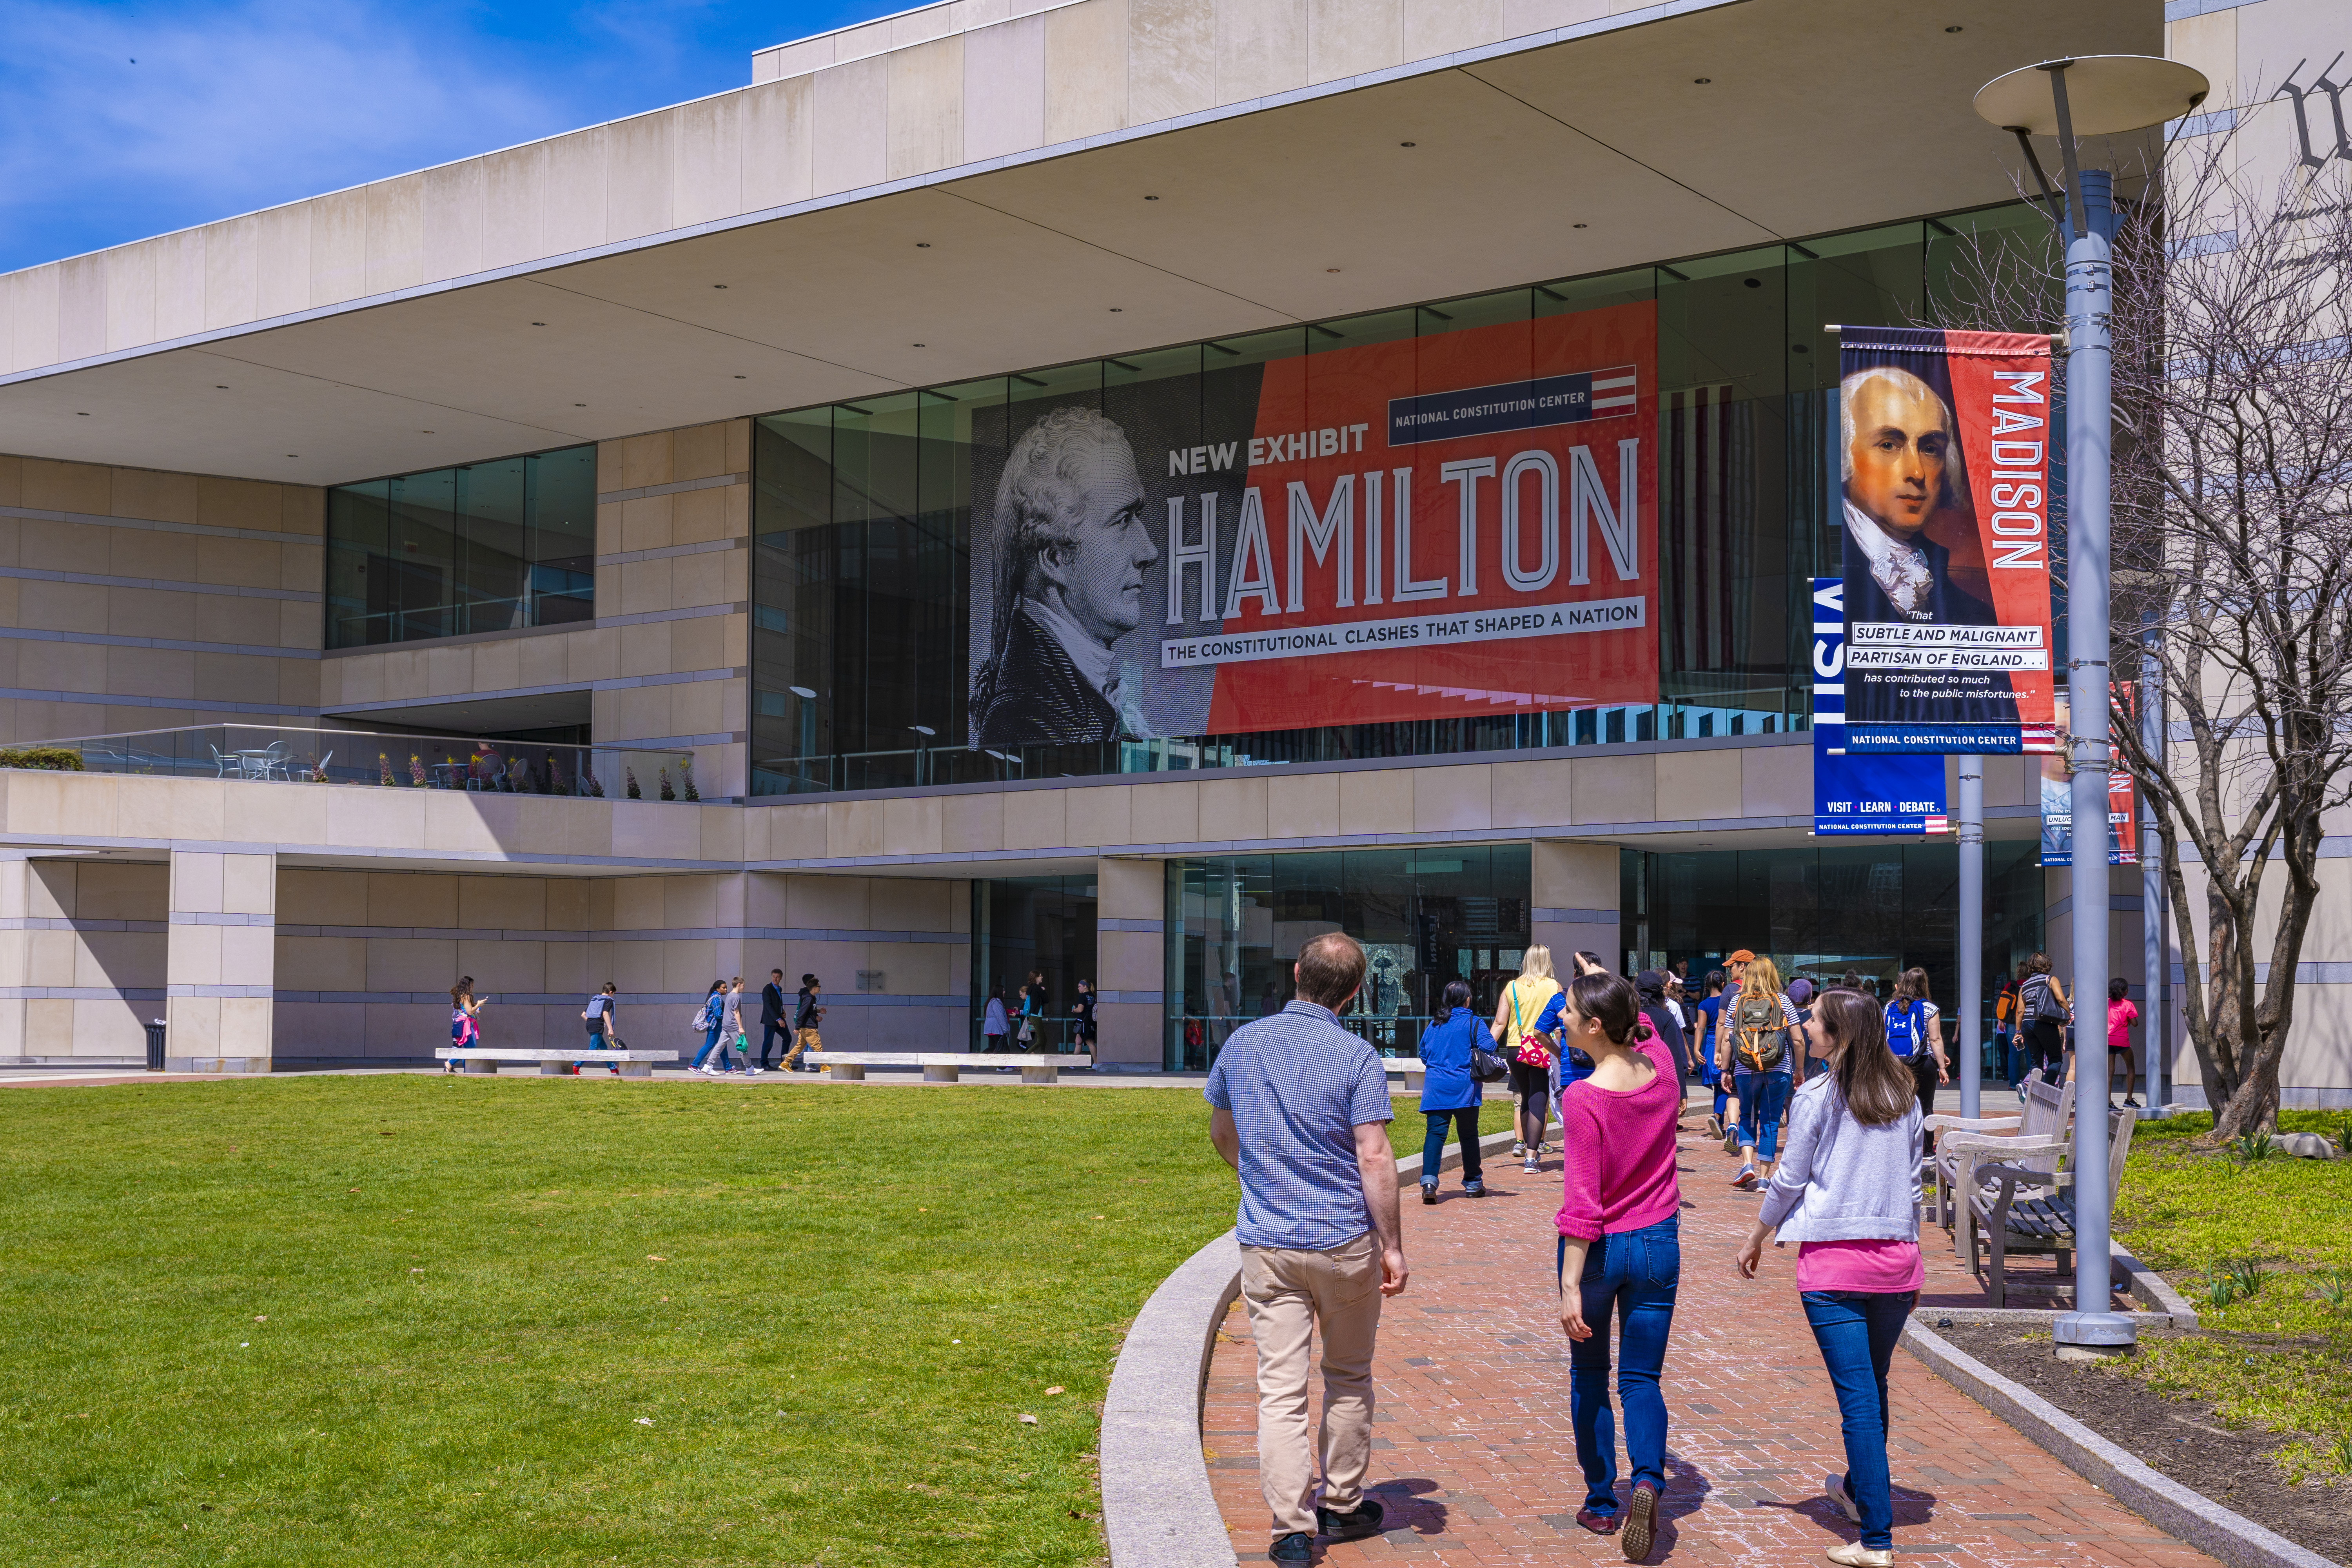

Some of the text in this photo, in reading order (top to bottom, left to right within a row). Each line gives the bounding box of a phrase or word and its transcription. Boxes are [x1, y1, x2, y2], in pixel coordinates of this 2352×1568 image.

[1396, 392, 1585, 428] NATIONAL CONSTITUTION CENTER
[1169, 423, 1368, 477] NEW EXHIBIT
[1991, 370, 2045, 569] MADISON
[1166, 437, 1640, 625] HAMILTON
[1906, 611, 1933, 620] “That
[1168, 605, 1638, 660] THE CONSTITUTIONAL CLASHES THAT SHAPED A NATION
[1856, 628, 2037, 642] SUBTLE AND MALIGNANT
[1814, 583, 1845, 724] VISI
[1851, 652, 1922, 664] PARTISAN
[1926, 653, 1948, 664] OF
[1864, 673, 1882, 682] has
[1885, 675, 1944, 683] contributed
[1932, 690, 1963, 699] public
[1966, 690, 2035, 699] misfortunes.”
[1828, 802, 1935, 812] VISIT LEARN DEBATE
